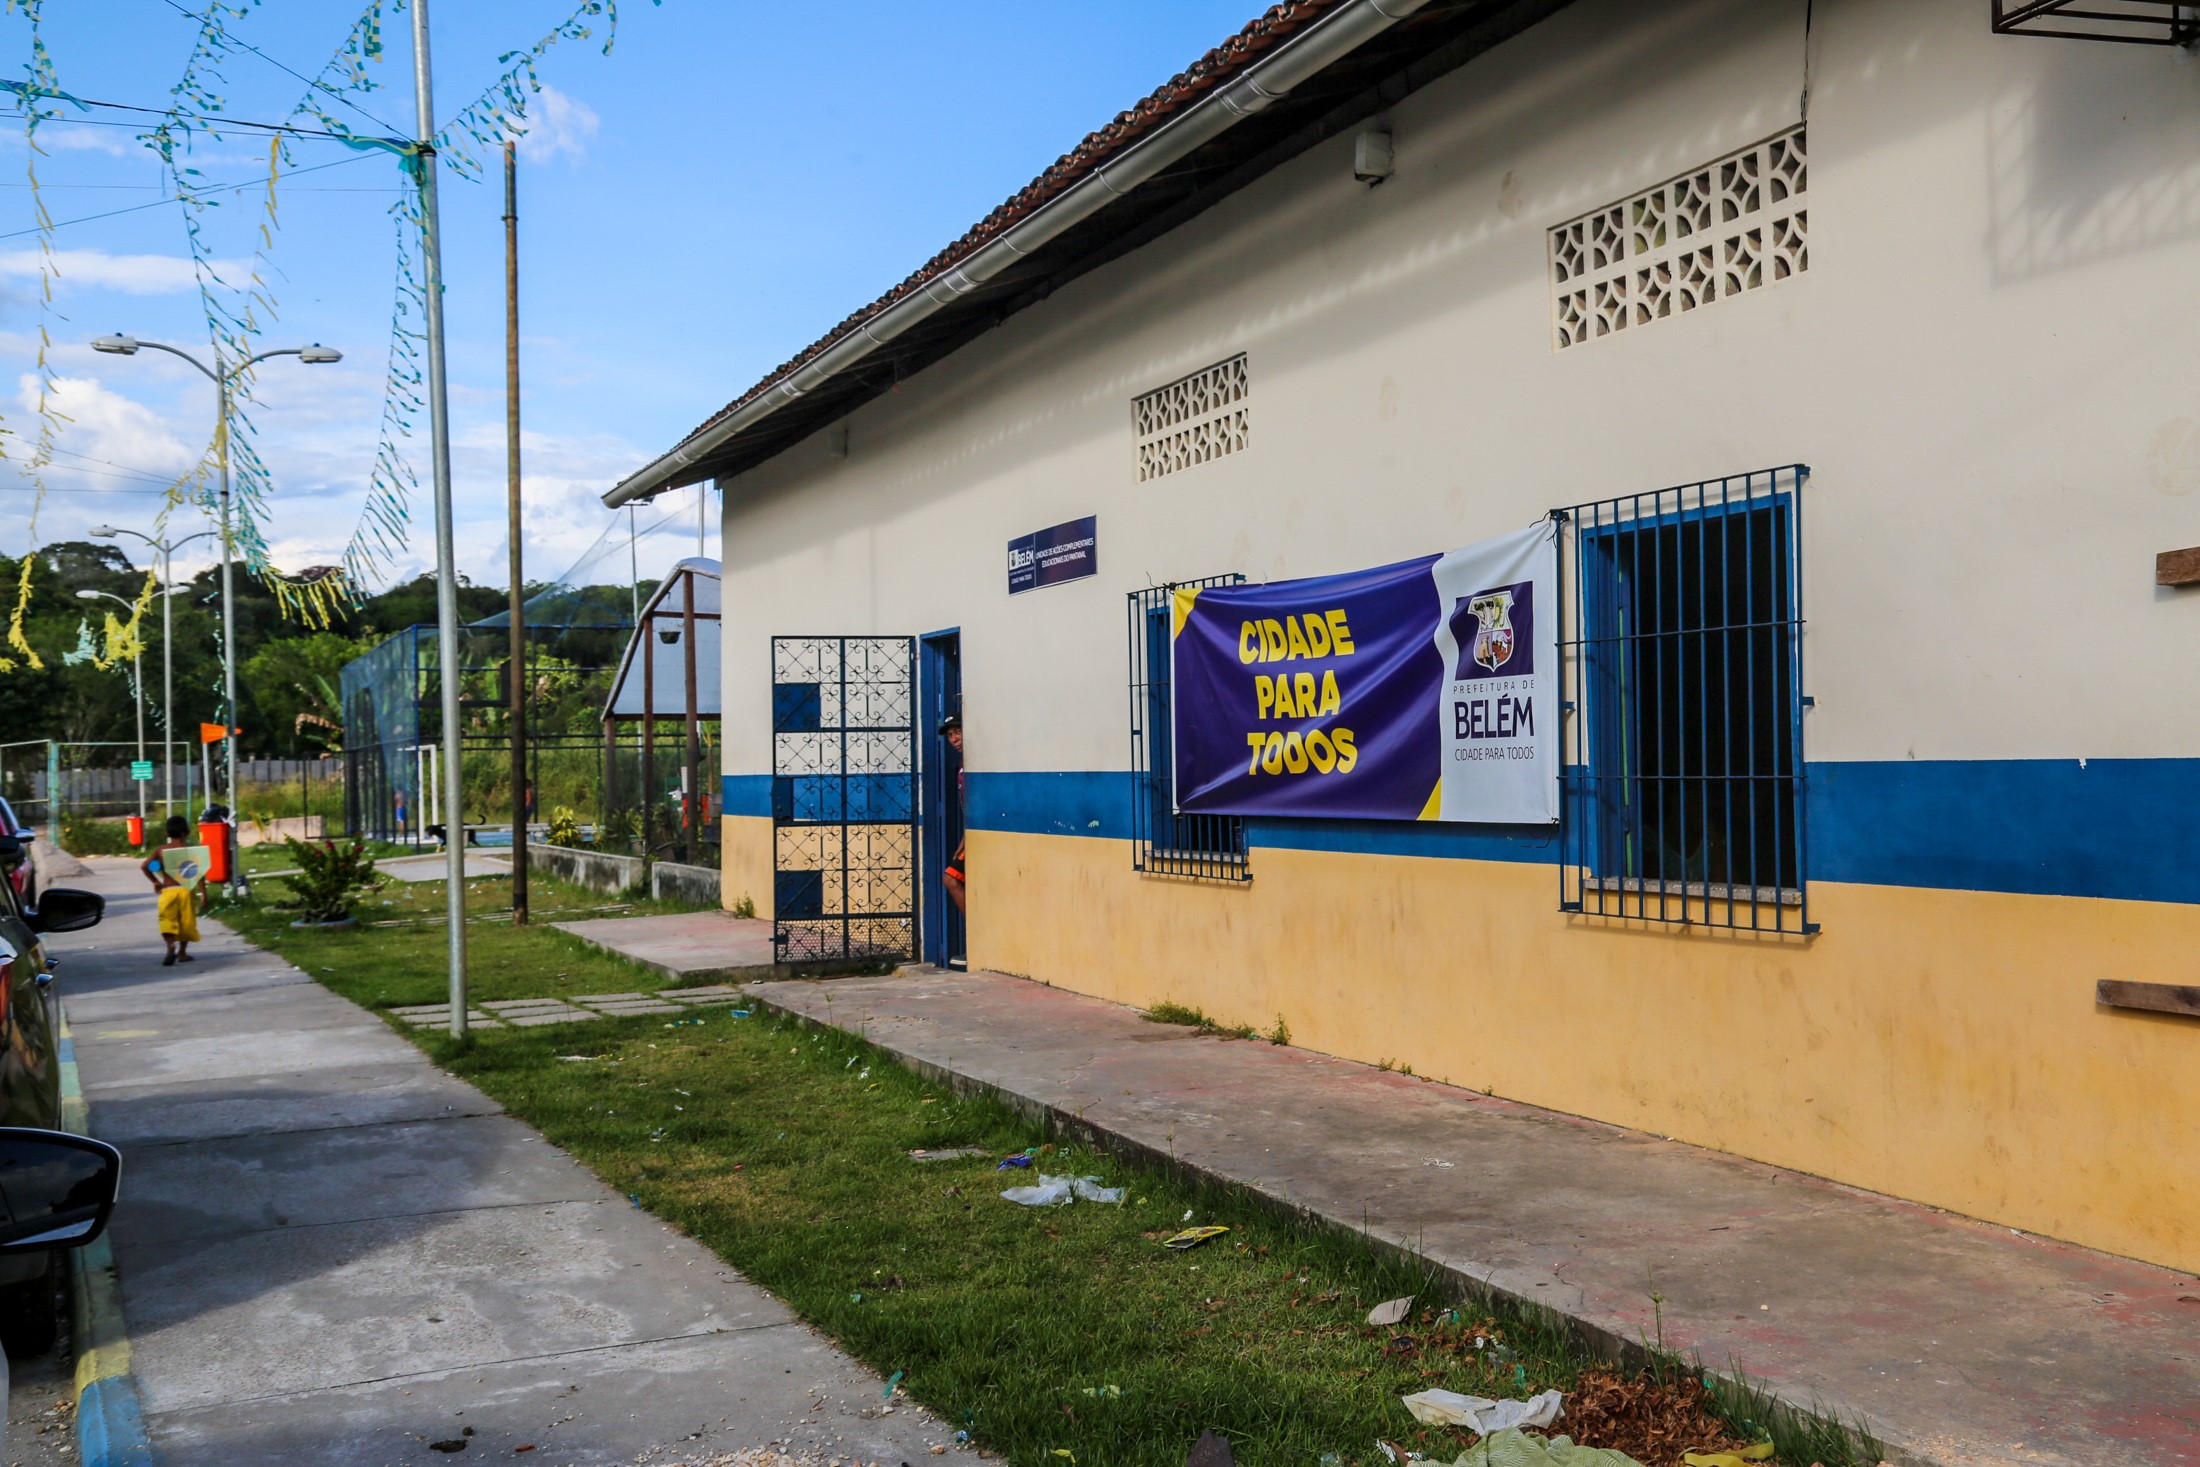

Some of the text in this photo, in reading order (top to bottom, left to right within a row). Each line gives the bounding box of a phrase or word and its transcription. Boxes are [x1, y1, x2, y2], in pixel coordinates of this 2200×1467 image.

[1018, 549, 1034, 567] BELÉM
[1238, 608, 1355, 665] CIDADE
[1254, 669, 1341, 719] PARA
[1453, 679, 1534, 694] PREFEITURA DE
[1454, 692, 1534, 740] BELÉM
[1247, 727, 1358, 775] TODOS
[1454, 746, 1534, 762] CIDADE PARA TODOS
